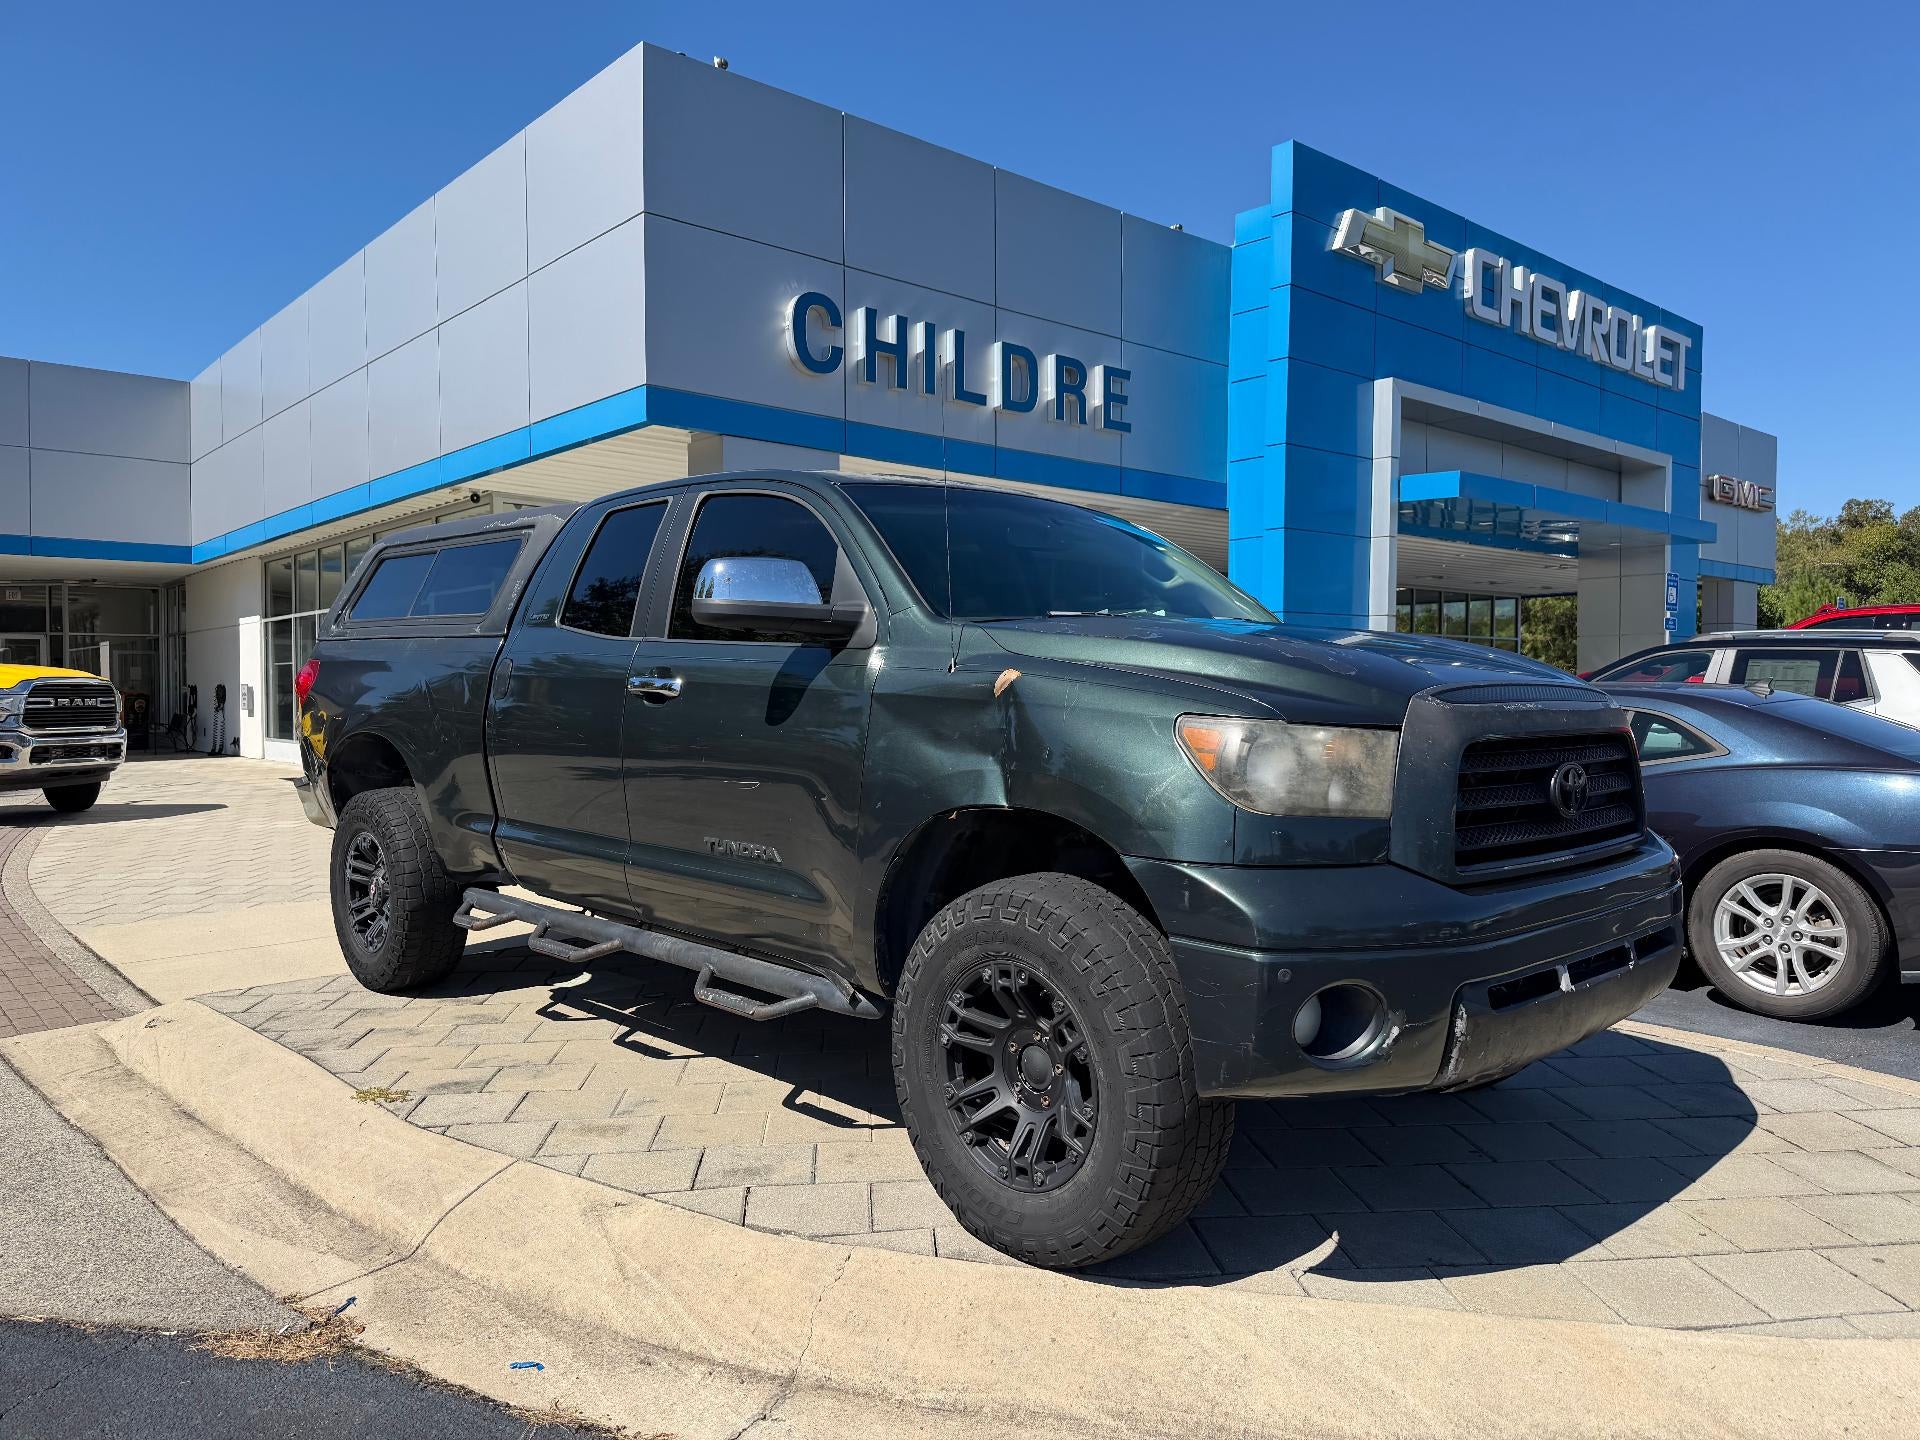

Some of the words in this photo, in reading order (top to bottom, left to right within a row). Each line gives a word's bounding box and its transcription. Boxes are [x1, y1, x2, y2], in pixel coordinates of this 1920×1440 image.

[1464, 248, 1692, 391] CHEVROLET
[786, 291, 1132, 434] CHILDRE
[1709, 474, 1774, 512] GMC
[57, 698, 97, 706] RAM
[703, 836, 783, 863] TUNDRA
